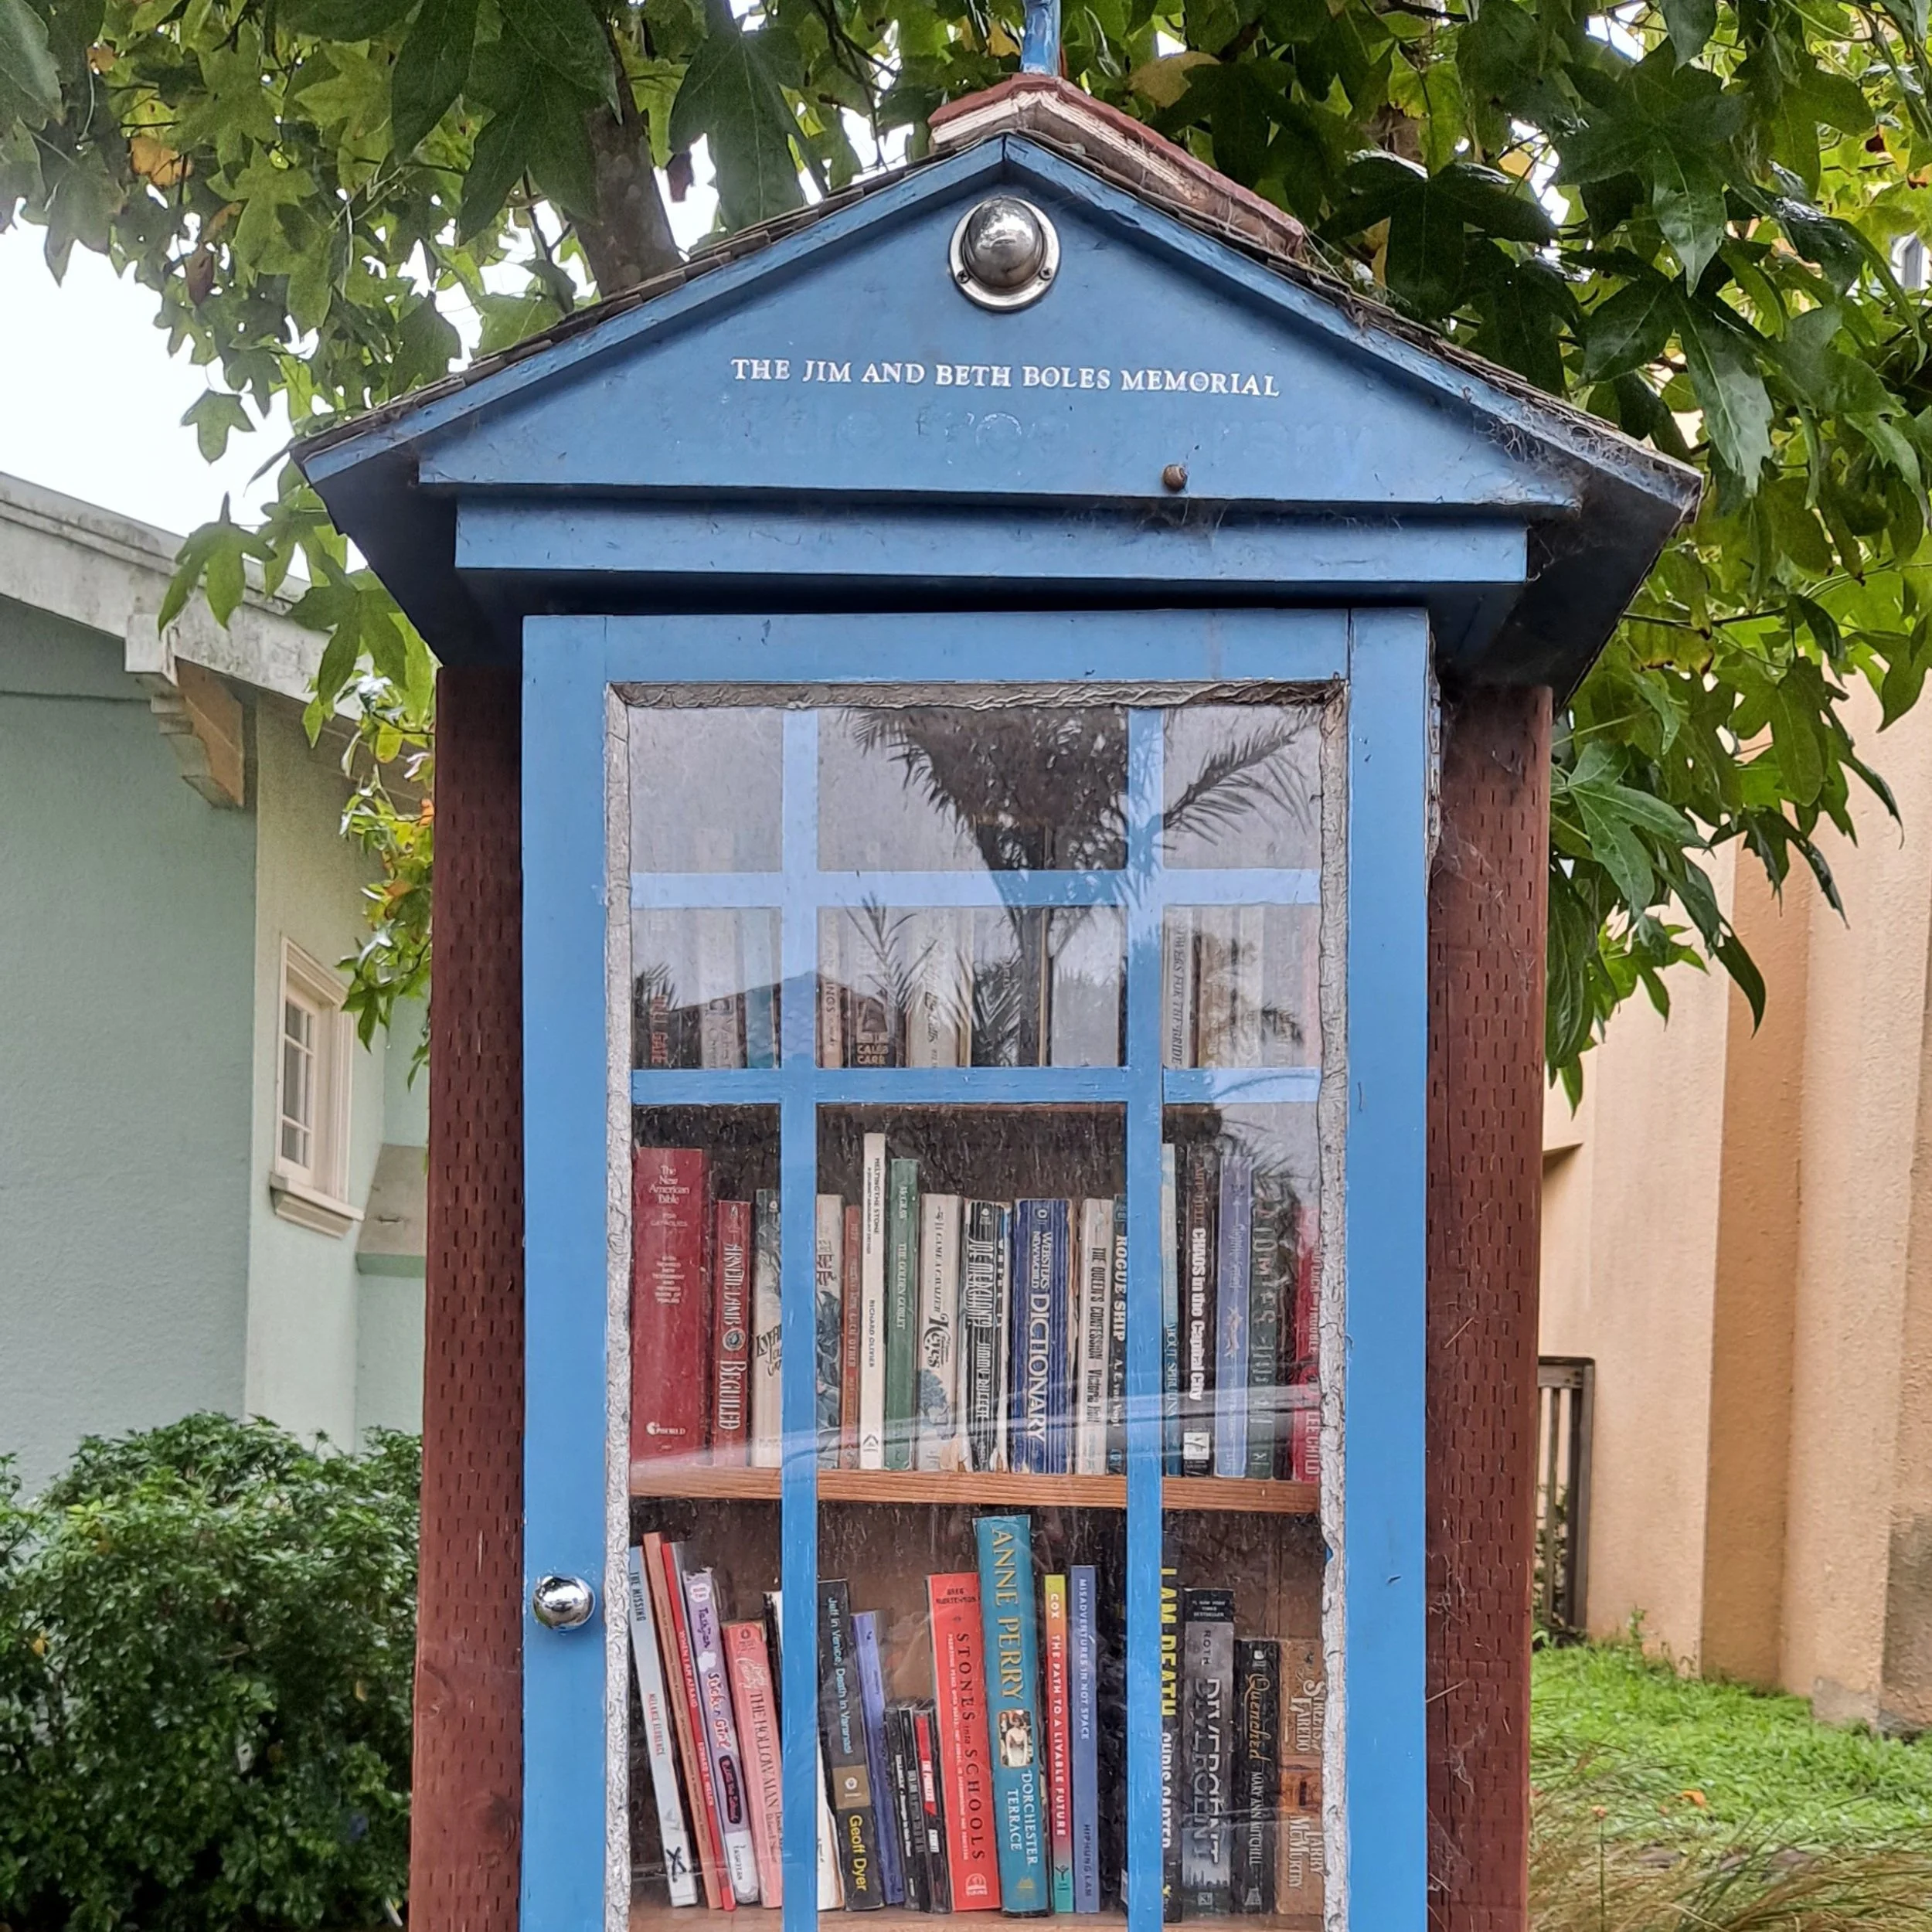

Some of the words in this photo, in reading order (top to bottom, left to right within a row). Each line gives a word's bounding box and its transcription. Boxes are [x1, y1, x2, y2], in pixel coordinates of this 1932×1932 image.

[730, 358, 791, 382] THE
[801, 359, 853, 384] JIM
[860, 361, 926, 386] AND
[934, 364, 1012, 388] BETH
[1022, 366, 1112, 390] BOLES
[1121, 369, 1281, 399] MEMORIAL
[1172, 1027, 1183, 1065] BRIDE
[658, 1175, 679, 1185] New
[661, 1165, 676, 1175] The
[649, 1185, 690, 1195] American
[658, 1195, 680, 1205] Bible
[723, 1243, 745, 1288] ARNETTE
[897, 1243, 907, 1259] THE
[968, 1237, 994, 1260] JOE
[1091, 1247, 1107, 1264] THE
[1114, 1235, 1128, 1294] ROGUE
[1192, 1227, 1206, 1276] CHAOS
[897, 1260, 907, 1295] GOLDEN
[1192, 1277, 1206, 1291] in
[724, 1291, 743, 1325] LAMB
[1113, 1300, 1127, 1342] SHIP
[1191, 1292, 1206, 1318] the
[923, 1313, 951, 1369] Keyes
[1088, 1306, 1104, 1360] CONFESSION
[1190, 1320, 1206, 1371] Capital
[975, 1340, 992, 1376] JIMMY
[1027, 1293, 1050, 1443] DICTIONARY
[1114, 1359, 1124, 1370] A.
[719, 1359, 747, 1430] BEGUILED
[1189, 1372, 1205, 1402] City
[1305, 1410, 1321, 1432] LEE
[1304, 1435, 1321, 1475] CHILD
[992, 1528, 1019, 1607] ANNE
[631, 1589, 647, 1622] MISSING
[828, 1597, 841, 1616] Jeff
[831, 1617, 841, 1628] in
[1050, 1593, 1060, 1619] COX
[1078, 1578, 1089, 1665] MISADVENTURES
[1162, 1588, 1179, 1624] AM
[832, 1629, 844, 1666] Venice,
[996, 1616, 1025, 1701] PERRY
[1051, 1634, 1061, 1658] THE
[1202, 1629, 1213, 1665] ROTH
[835, 1668, 849, 1699] Death
[956, 1633, 976, 1721] STONES
[1052, 1662, 1063, 1694] PATH
[1080, 1668, 1088, 1680] IN
[1162, 1634, 1177, 1716] DEATH
[687, 1678, 699, 1709] AFRAID
[706, 1672, 726, 1714] Sticker
[750, 1691, 767, 1719] THE
[1053, 1699, 1063, 1715] TO
[1080, 1682, 1090, 1705] NOT
[1303, 1679, 1325, 1740] STREETS
[714, 1719, 733, 1750] Girl
[841, 1711, 855, 1754] Varanasi
[1053, 1718, 1063, 1727] A
[1080, 1708, 1090, 1740] SPACE
[1244, 1673, 1272, 1762] Quenched
[1288, 1696, 1313, 1752] LAREDO
[754, 1720, 776, 1776] HOLLOW
[1054, 1731, 1064, 1783] LIVABLE
[1193, 1678, 1222, 1863] DIVERGENT
[1250, 1770, 1264, 1798] MARY
[763, 1777, 781, 1809] MAN
[964, 1749, 985, 1860] SCHOOLS
[1006, 1787, 1023, 1852] TERRACE
[1019, 1770, 1039, 1866] DORCHESTER
[1056, 1787, 1066, 1837] FUTURE
[849, 1814, 867, 1853] Geoff
[1304, 1829, 1325, 1874] LARRY
[851, 1856, 868, 1892] Dyer
